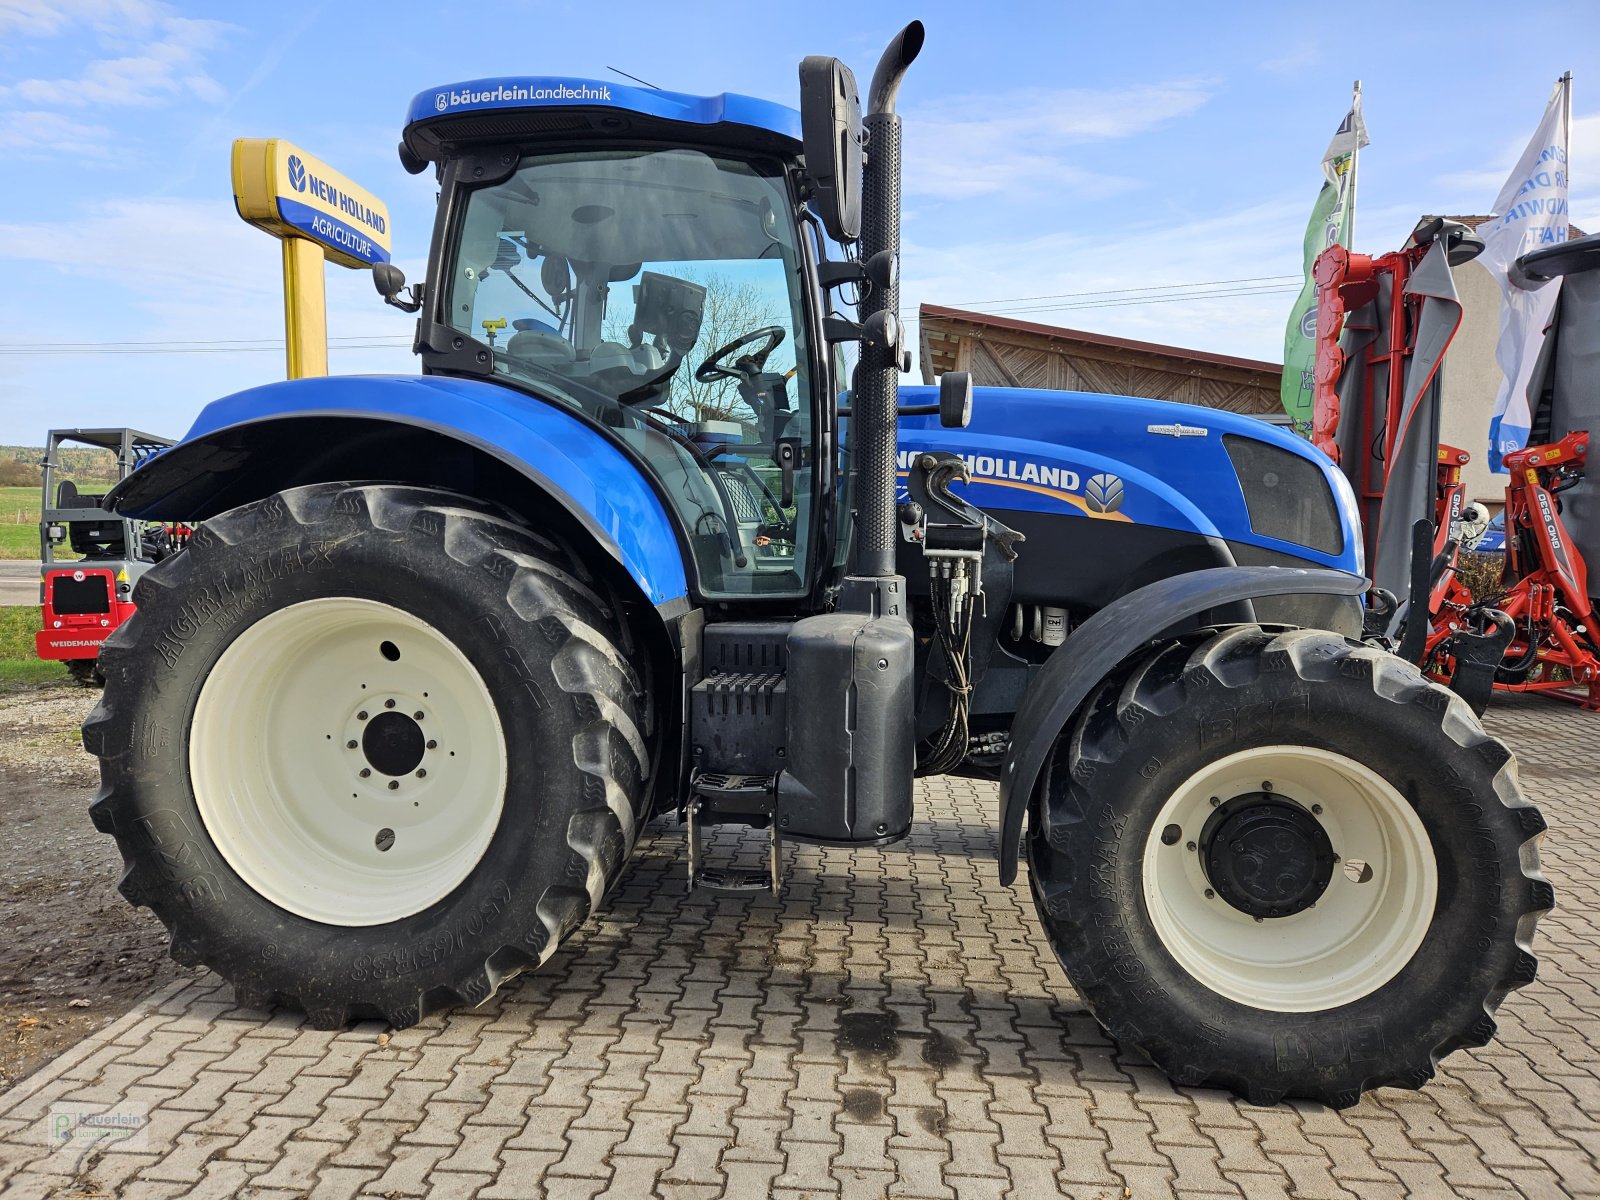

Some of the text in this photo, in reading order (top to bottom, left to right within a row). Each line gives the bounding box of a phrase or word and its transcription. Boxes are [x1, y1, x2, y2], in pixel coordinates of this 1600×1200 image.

[451, 84, 611, 105] bäuerlein Landtechnik
[308, 174, 385, 235] NEW HOLLAND
[312, 216, 371, 257] AGRICULTURE
[1451, 494, 1461, 517] GMD
[1538, 493, 1561, 549] GMD 9530
[153, 540, 337, 669] AGRI MAX
